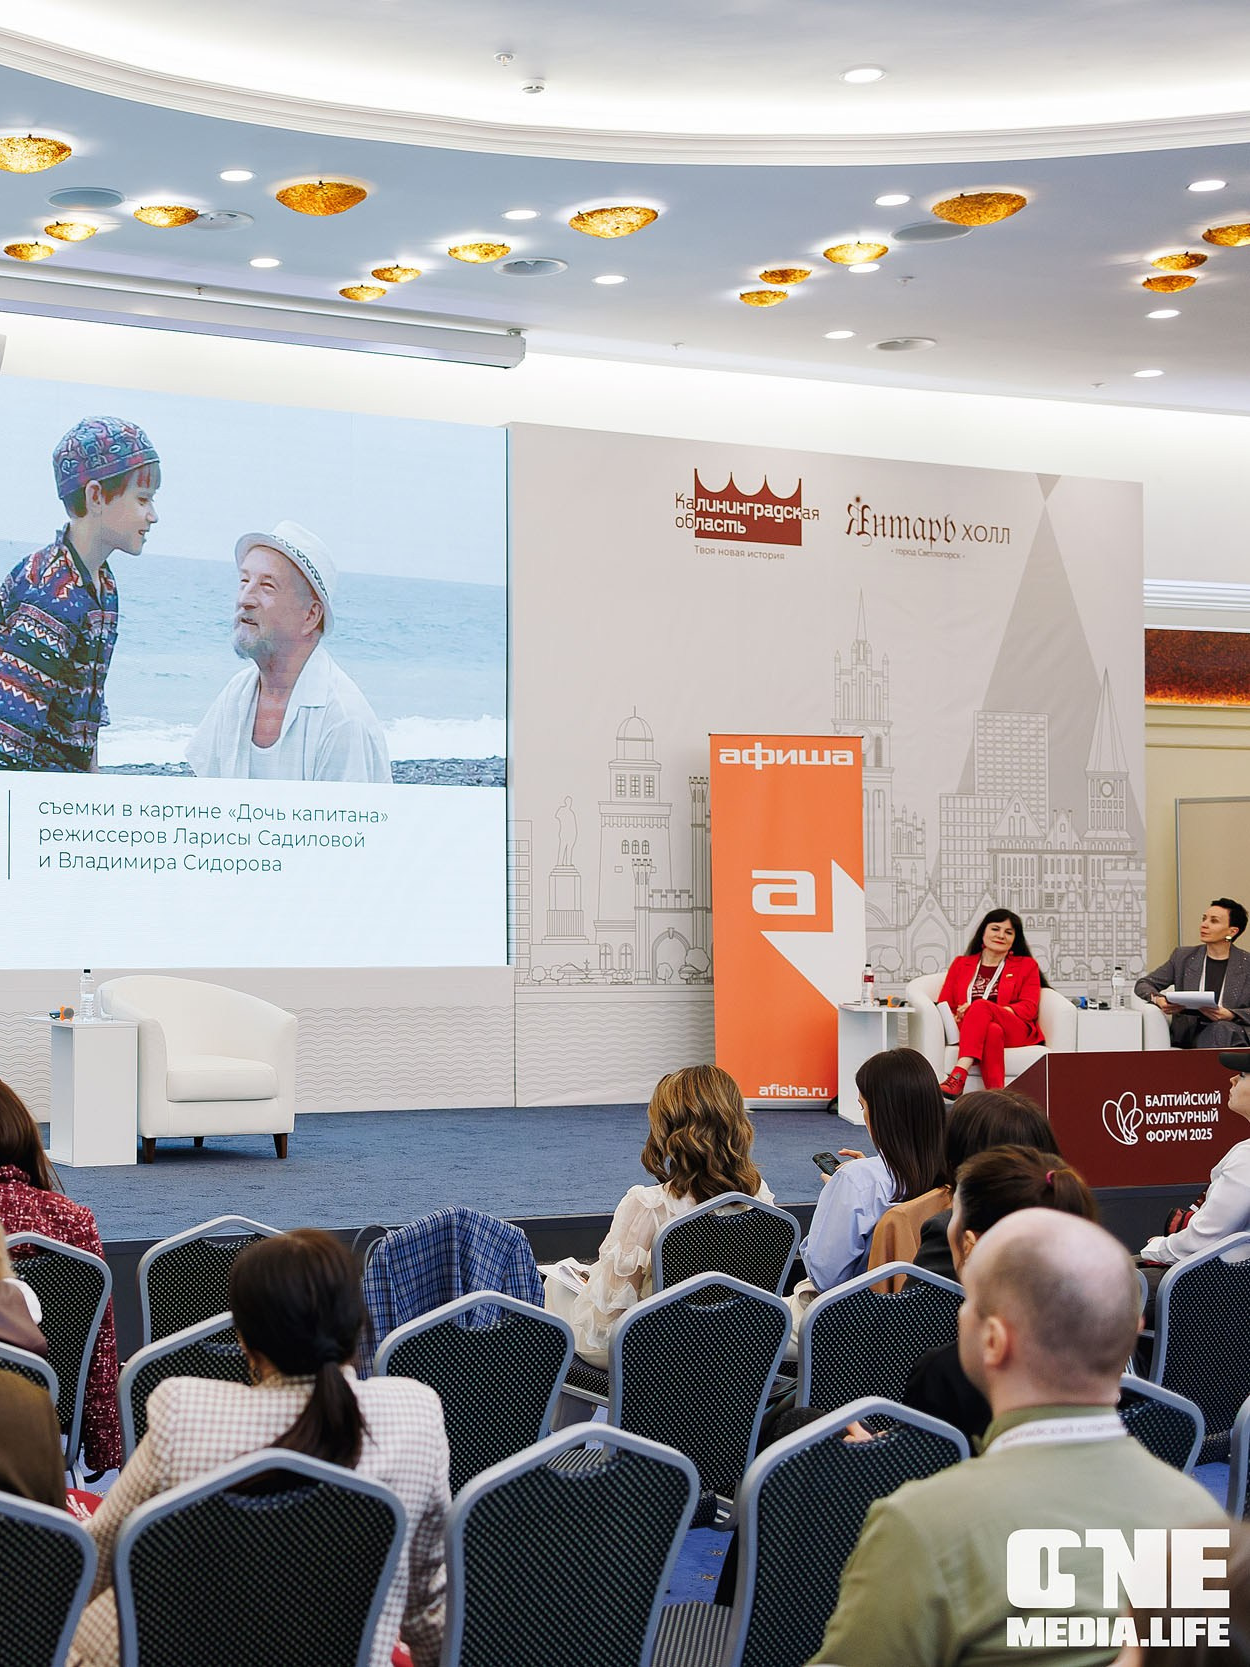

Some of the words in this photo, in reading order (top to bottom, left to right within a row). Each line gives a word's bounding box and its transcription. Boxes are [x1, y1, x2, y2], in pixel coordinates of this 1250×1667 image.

[675, 492, 820, 523] Калининградская
[675, 513, 747, 534] область
[846, 496, 957, 549] Янтарь
[718, 549, 745, 557] новая
[747, 550, 785, 560] история
[719, 742, 854, 770] афиша
[38, 800, 115, 816] съемки
[122, 804, 133, 817] в
[139, 803, 222, 820] картине
[228, 803, 286, 822] «Дочь
[291, 807, 389, 824] капитана»
[38, 828, 168, 846] режиссеров
[173, 827, 251, 848] Ларисы
[257, 829, 366, 849] Садиловой
[39, 856, 51, 868] и
[58, 852, 177, 872] Владимира
[183, 853, 283, 874] Сидорова
[758, 1083, 829, 1097] afisha.ru
[1145, 1090, 1221, 1107] БАЛТИЙСКИЙ
[1145, 1108, 1219, 1125] КУЛЬТУРНЫЙ
[1146, 1130, 1188, 1142] ФОРУМ
[1190, 1128, 1213, 1141] 2025
